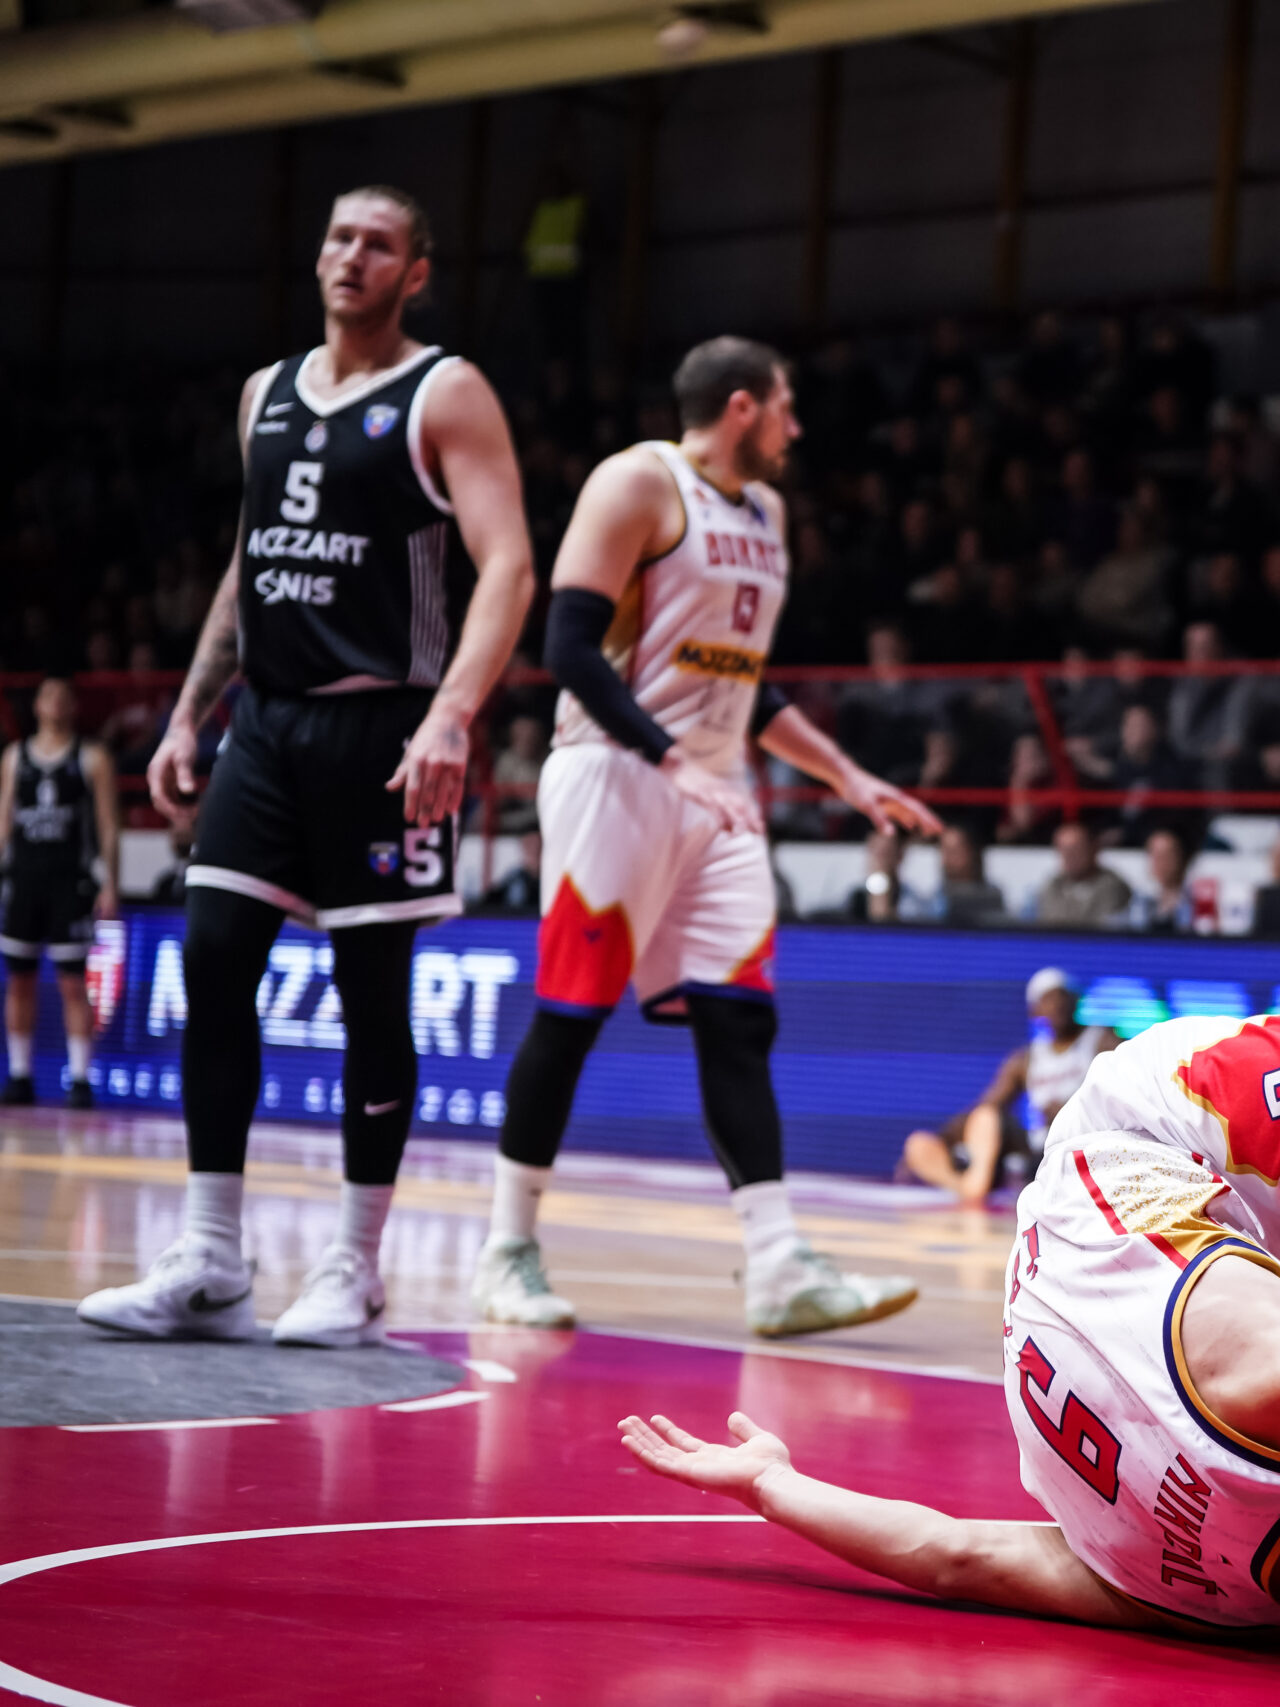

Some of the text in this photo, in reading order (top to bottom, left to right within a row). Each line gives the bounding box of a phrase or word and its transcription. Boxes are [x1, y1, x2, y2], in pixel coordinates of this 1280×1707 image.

[279, 460, 324, 524] 5
[279, 569, 336, 606] NIS
[404, 828, 443, 887] 5
[147, 936, 520, 1060] MZZRT
